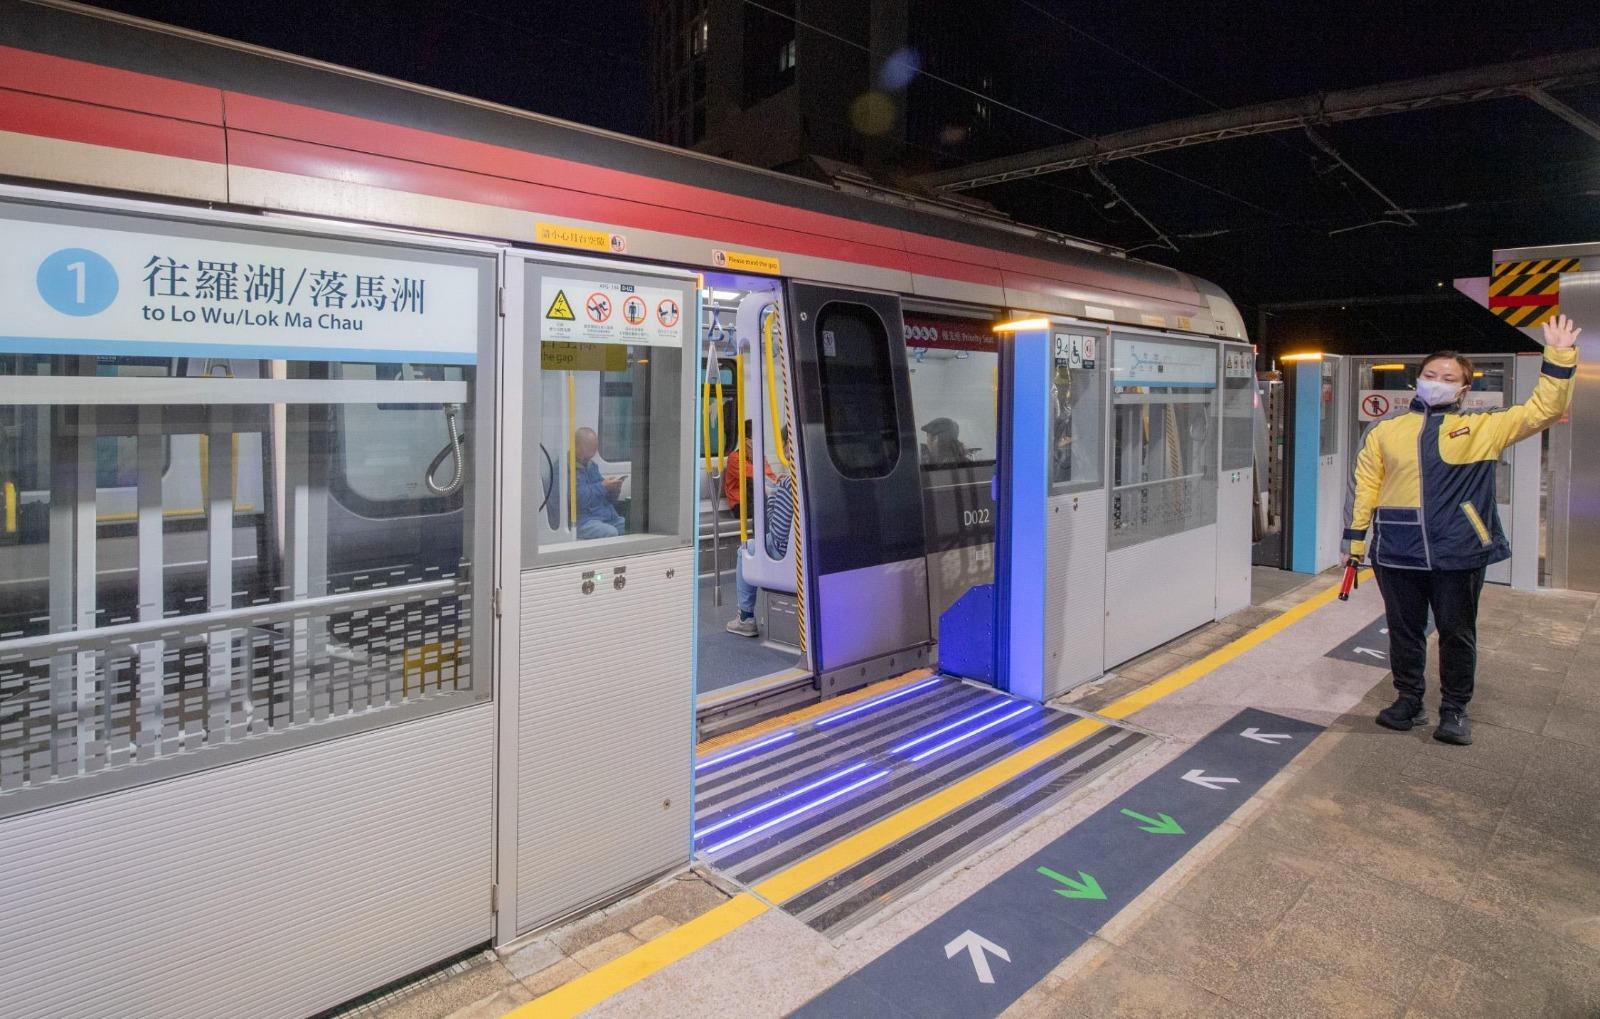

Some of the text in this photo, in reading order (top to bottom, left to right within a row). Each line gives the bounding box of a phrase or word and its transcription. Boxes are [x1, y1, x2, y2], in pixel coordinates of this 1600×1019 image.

[66, 261, 86, 304] 1
[142, 254, 426, 315] 往羅湖/落馬洲
[142, 304, 363, 332] to Lo Wu/Lok Ma Chau
[556, 354, 574, 364] gap
[963, 508, 990, 526] D022
